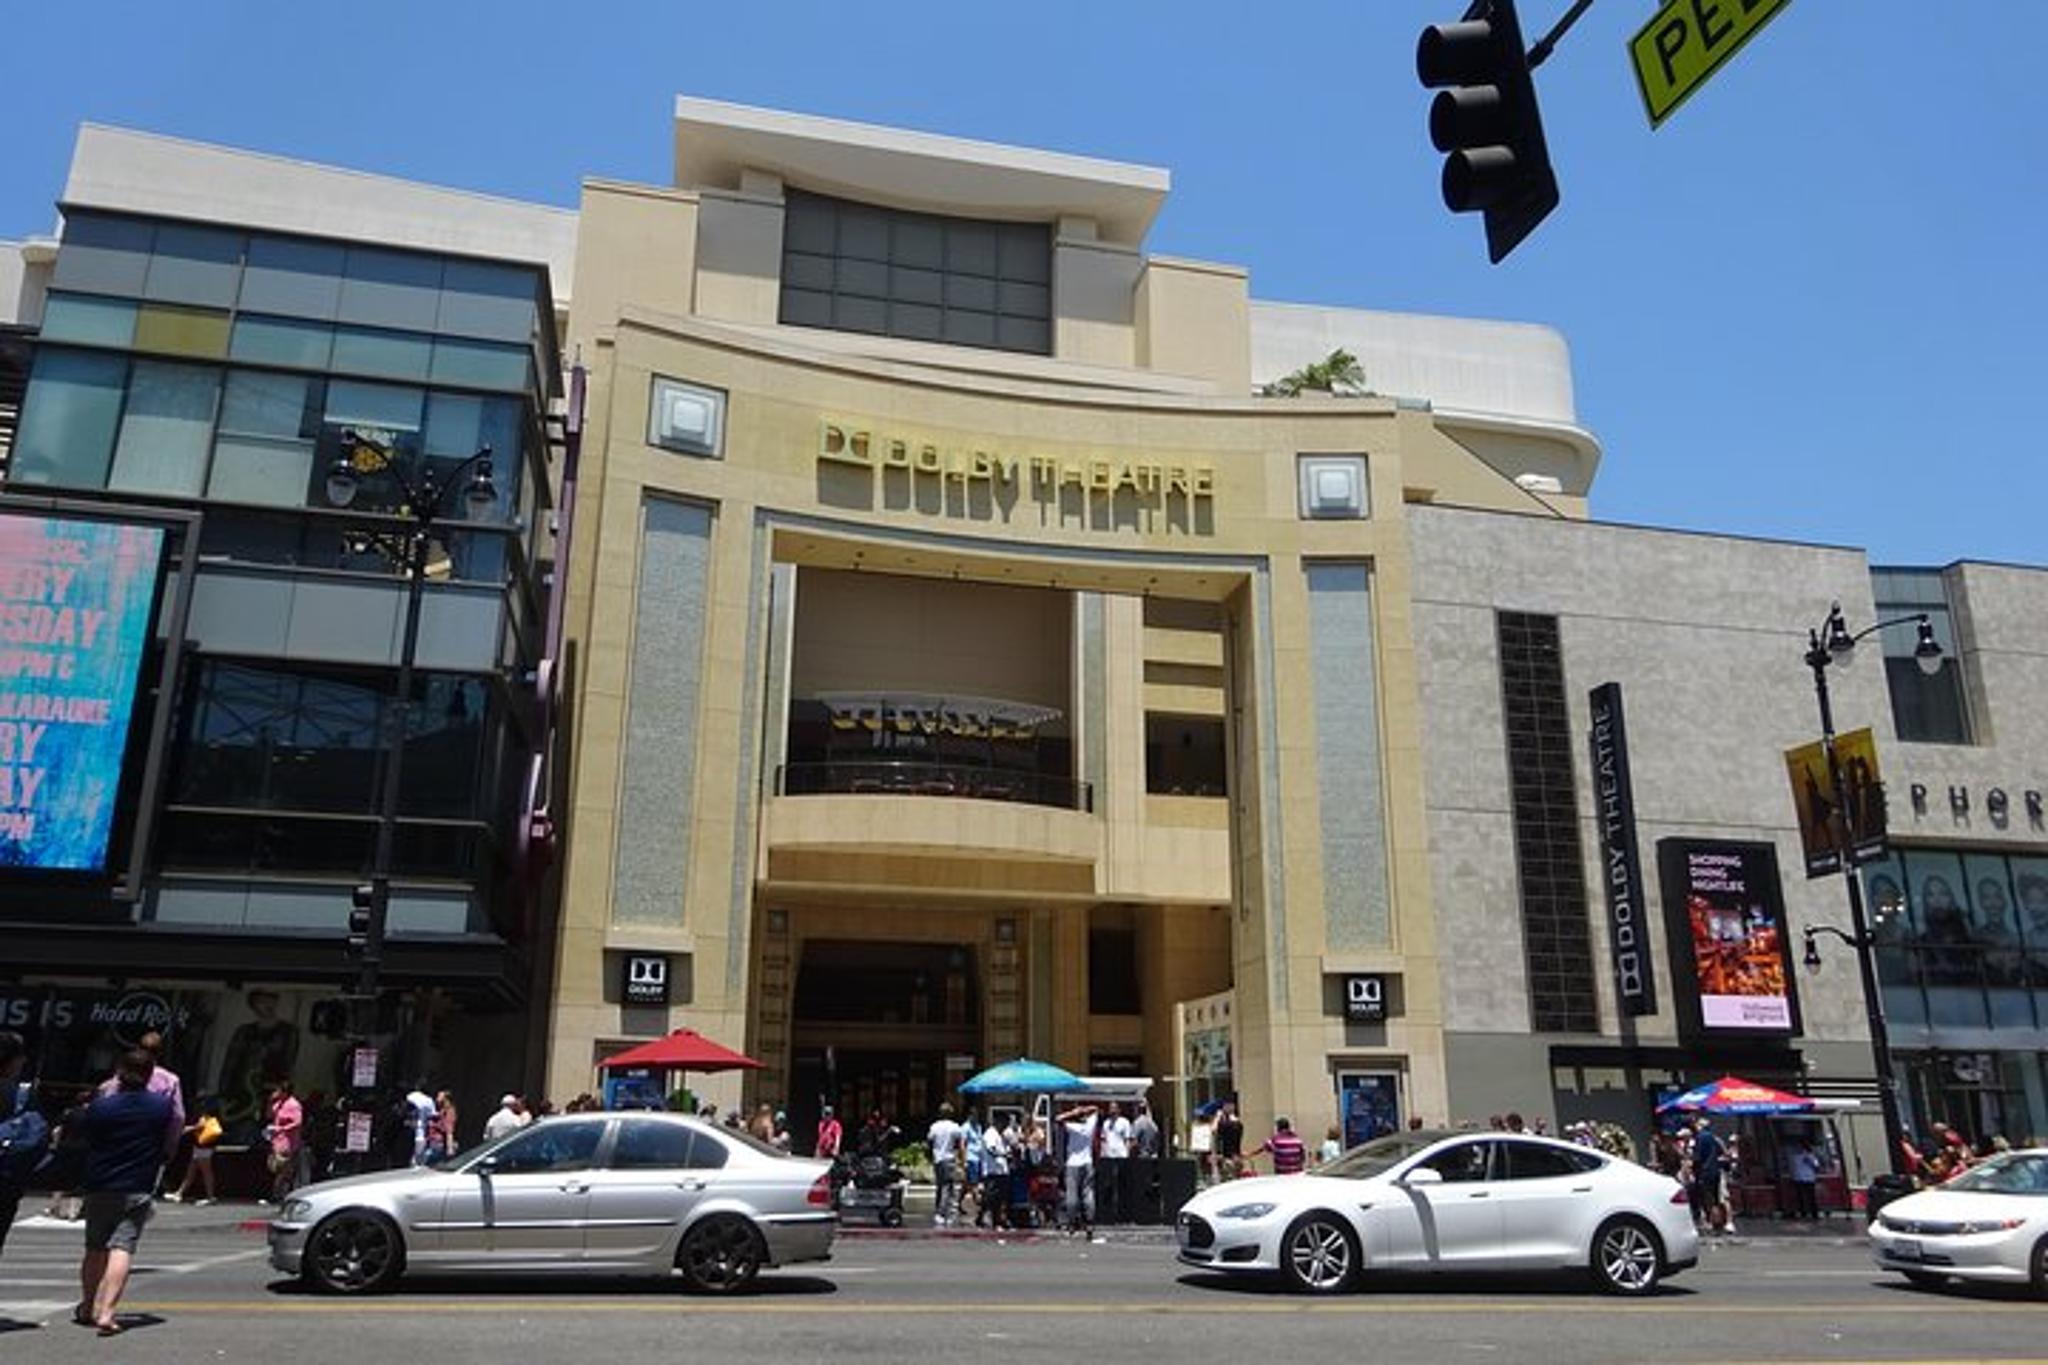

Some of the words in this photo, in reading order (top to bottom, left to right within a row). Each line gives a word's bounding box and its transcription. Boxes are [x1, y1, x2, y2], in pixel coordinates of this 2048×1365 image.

[1655, 0, 1764, 87] PE
[1595, 703, 1622, 840] THEATRE
[1608, 848, 1635, 947] DOLBY
[39, 1000, 73, 1028] IS
